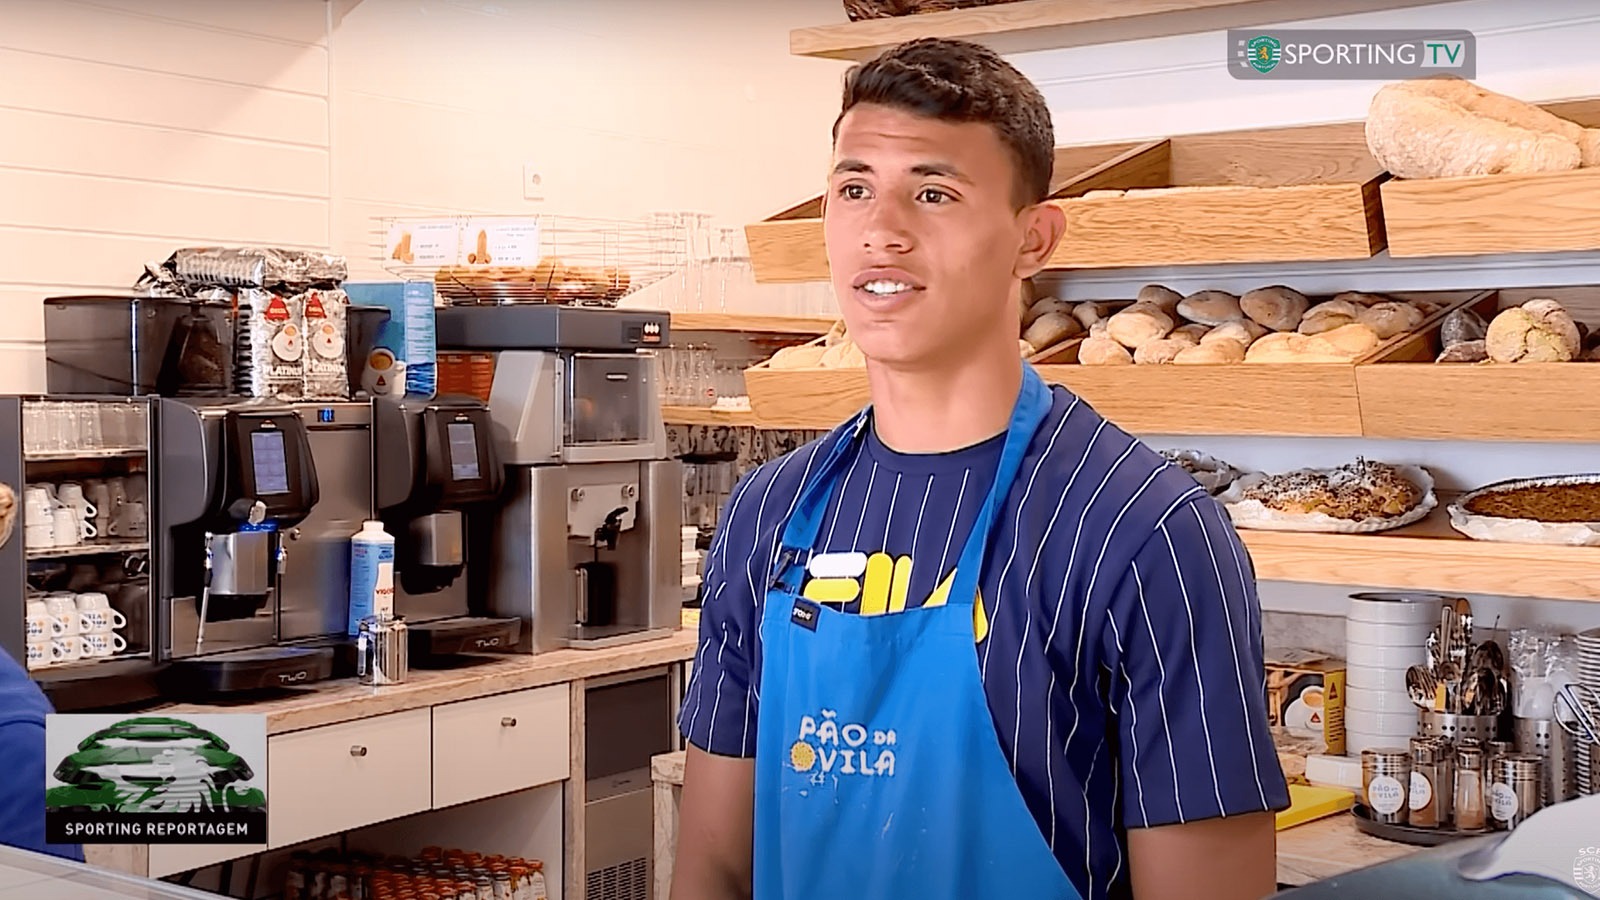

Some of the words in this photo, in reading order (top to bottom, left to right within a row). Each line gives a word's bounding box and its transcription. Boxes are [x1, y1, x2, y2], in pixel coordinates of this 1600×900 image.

[475, 638, 500, 648] TWO
[278, 671, 307, 683] TWO
[799, 708, 868, 747] PÃO
[874, 730, 898, 746] DA
[818, 747, 897, 777] VILA
